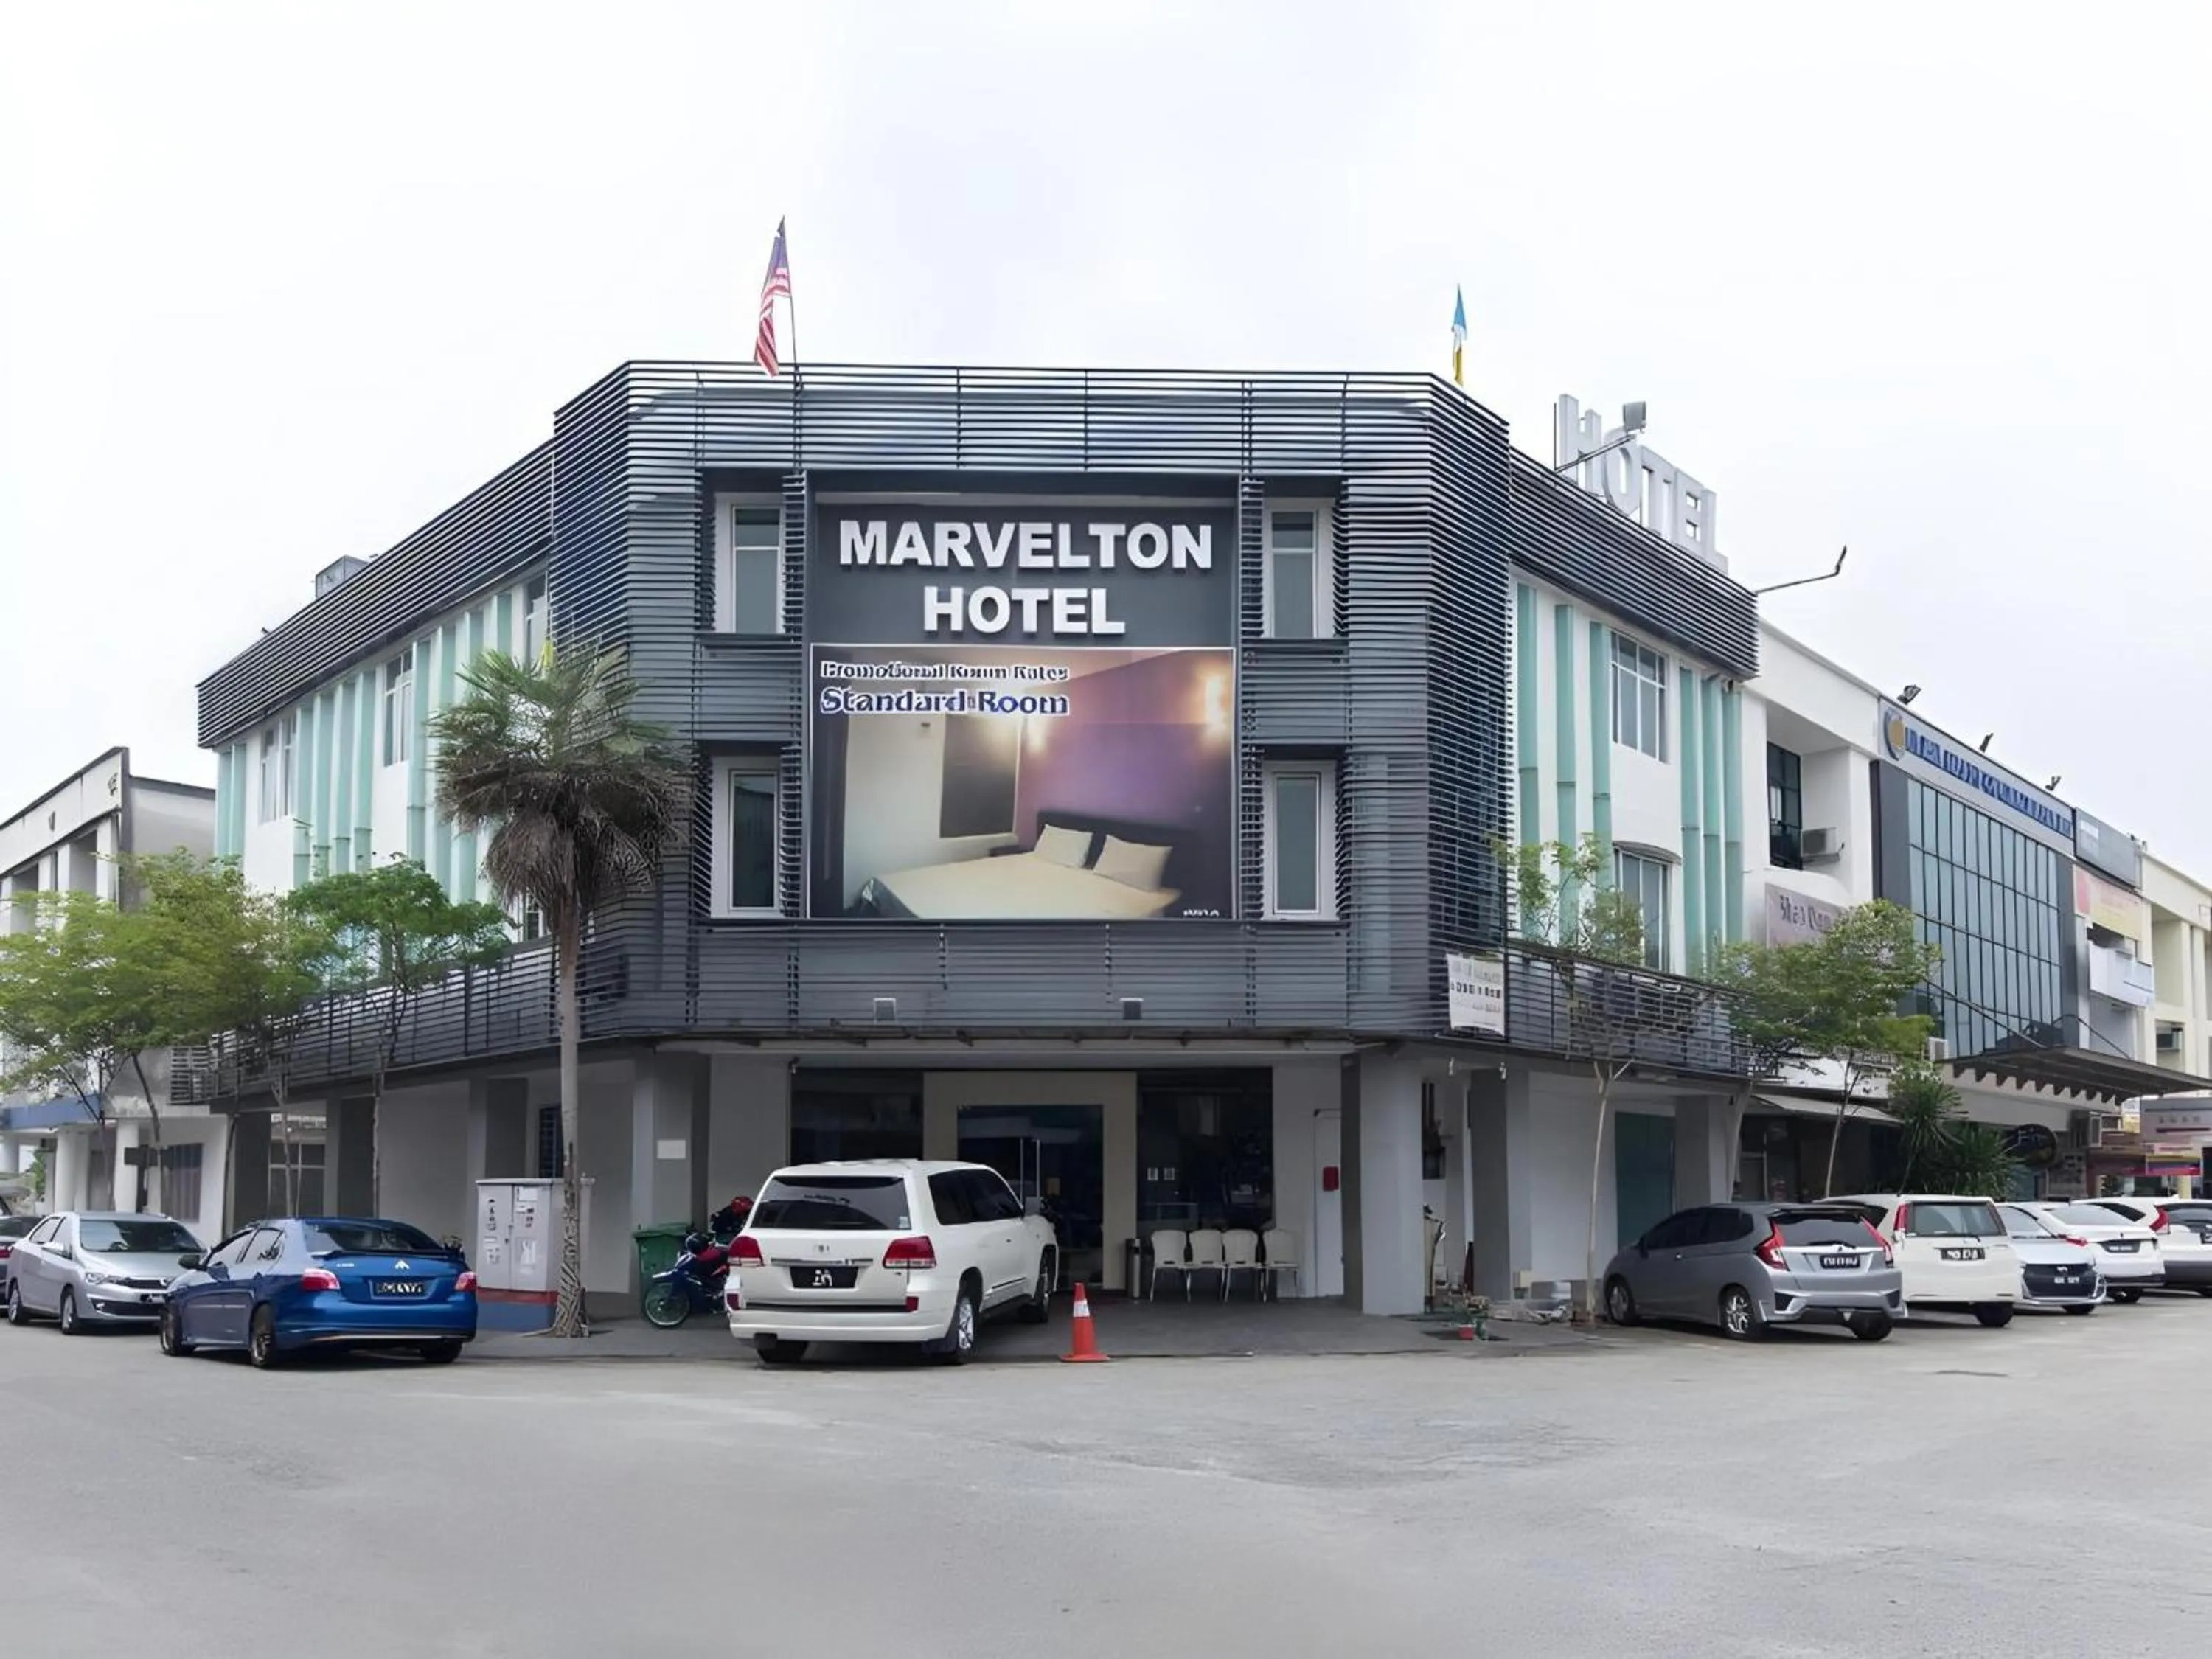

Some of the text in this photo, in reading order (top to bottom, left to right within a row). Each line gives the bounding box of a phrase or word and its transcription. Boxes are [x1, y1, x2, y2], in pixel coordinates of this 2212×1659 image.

[1559, 394, 1729, 575] HOTEL
[839, 519, 1213, 569] MARVELTON
[923, 585, 1126, 634] HOTEL
[821, 686, 1070, 714] Standard Room
